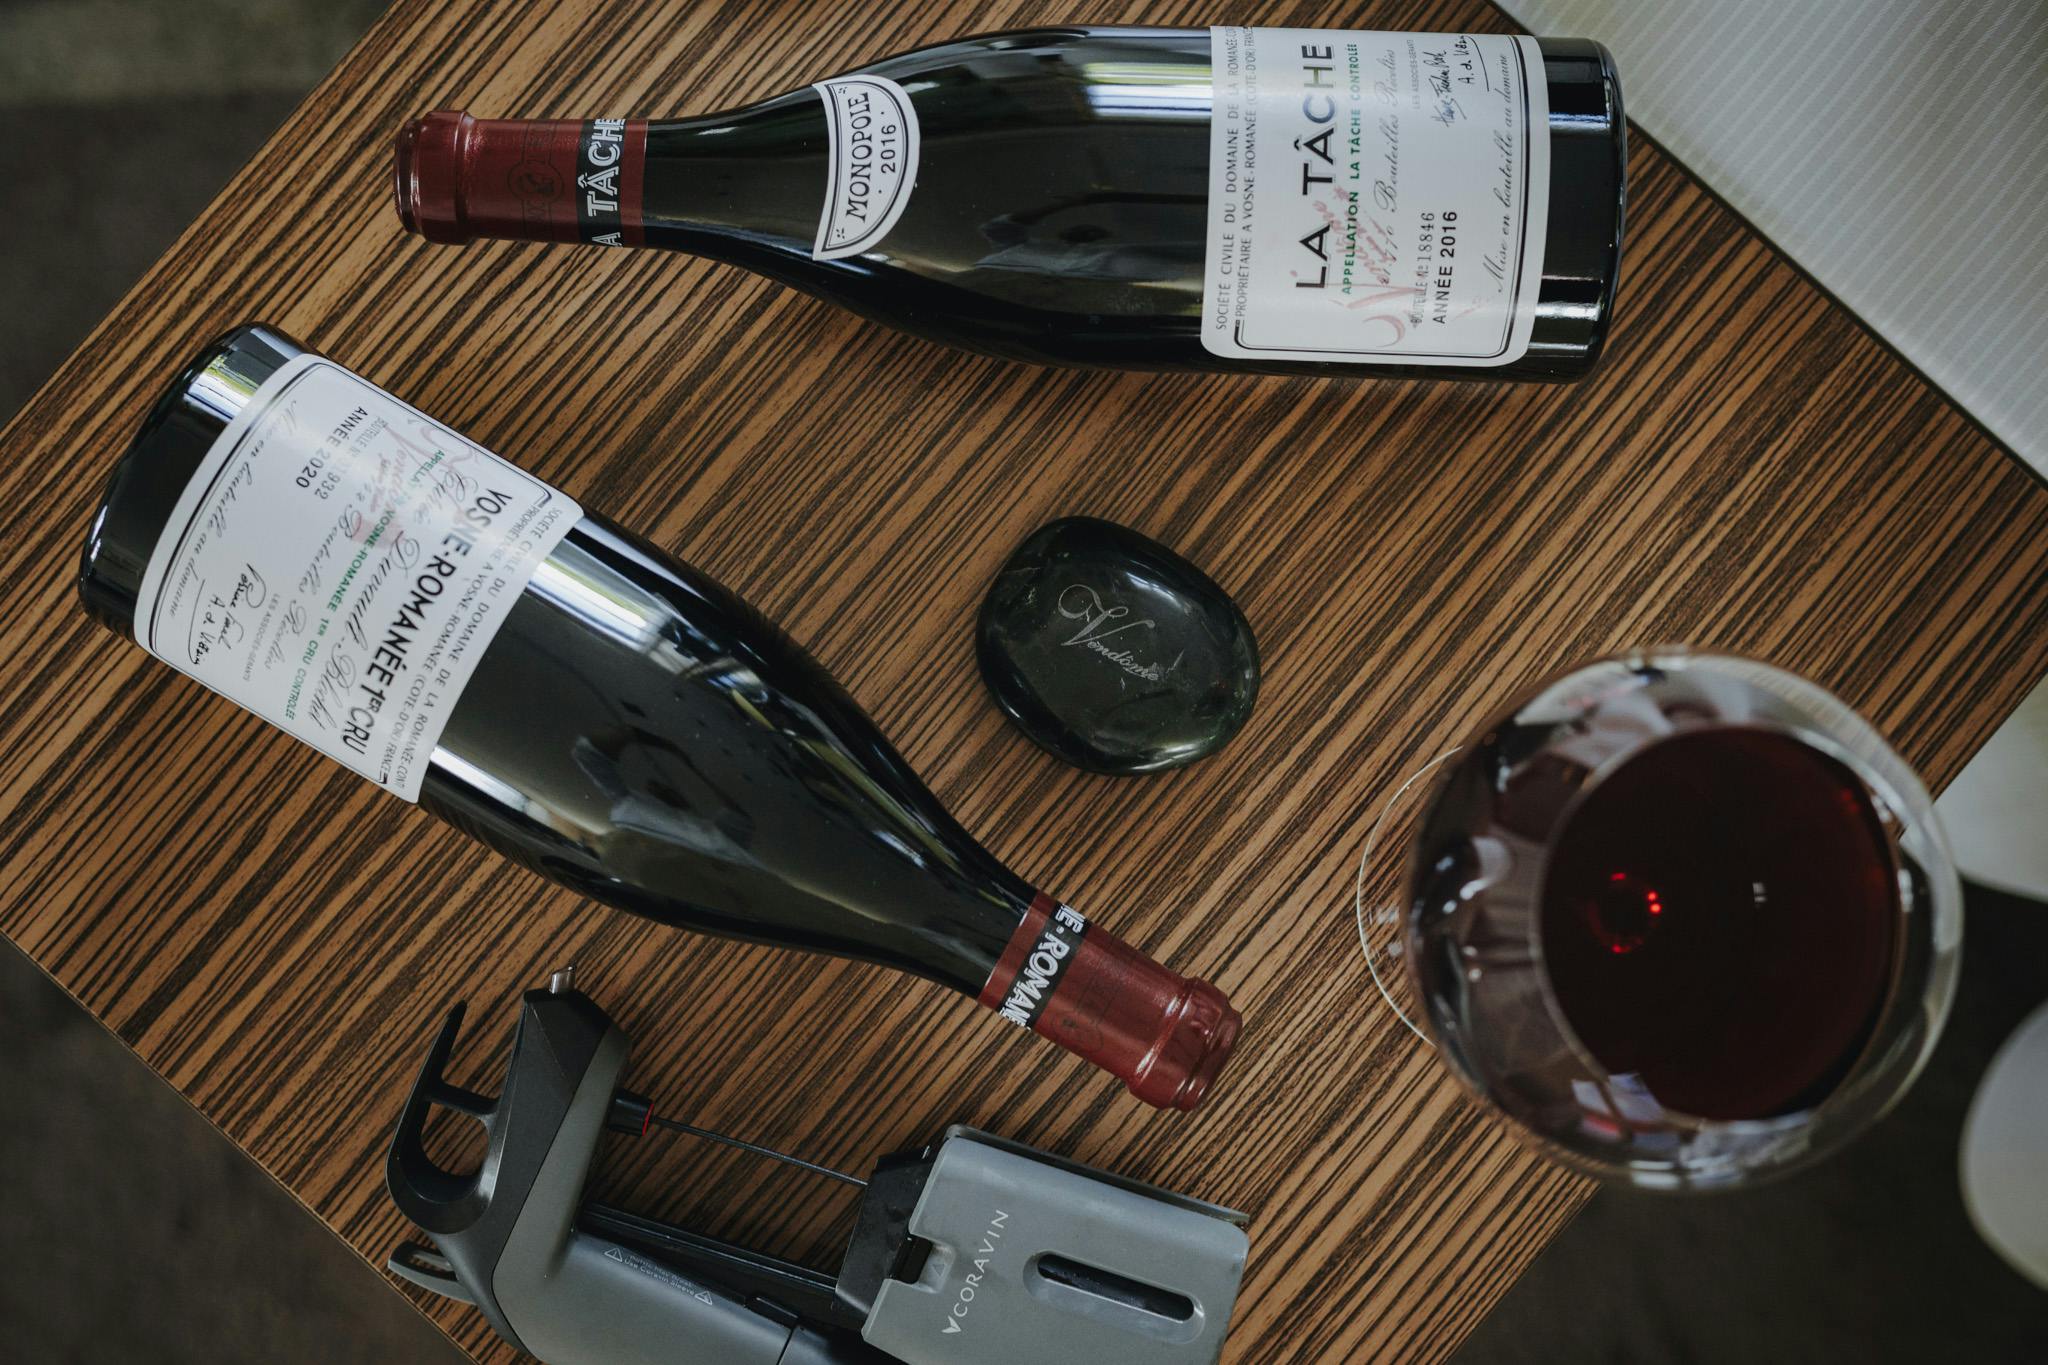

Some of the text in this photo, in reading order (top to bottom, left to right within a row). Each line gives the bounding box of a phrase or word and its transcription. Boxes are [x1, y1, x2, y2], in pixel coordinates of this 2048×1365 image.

[1227, 84, 1238, 96] LA
[1228, 104, 1238, 119] DE
[881, 125, 895, 173] 2016
[1348, 109, 1360, 153] TÂCHE
[577, 117, 625, 215] TÂCHE
[845, 92, 873, 222] MONOPOLE
[1226, 128, 1238, 193] DOMAINE
[1294, 45, 1334, 289] LA TÂCHE
[1349, 162, 1360, 179] LA
[1374, 114, 1398, 212] Bouteilles
[1483, 55, 1512, 292] Mise en bouteille au domaine
[1224, 203, 1236, 223] DU
[1220, 234, 1233, 274] CIVILE
[1342, 192, 1358, 294] APPELLATION
[1236, 238, 1251, 316] PROPRIÉTAIRE
[1244, 224, 1252, 232] A
[1433, 212, 1457, 324] ANNÉE 2016
[1216, 282, 1230, 330] SOCIÉTÉ
[249, 438, 264, 458] en
[325, 406, 368, 448] ANNÉE
[294, 447, 331, 489] 2020
[206, 461, 255, 537] bouteille
[530, 507, 562, 538] SOCIÉTÉ
[192, 532, 208, 555] au
[297, 504, 362, 595] Bouteilles
[326, 512, 395, 612] VOSNE-ROMANÉE
[481, 561, 492, 571] A
[168, 557, 199, 615] domaine
[365, 489, 512, 686] VOSNE-ROMANÉE
[486, 576, 506, 597] DU
[301, 640, 318, 664] CRU
[447, 601, 489, 663] DOMAINE
[423, 691, 438, 708] LA
[433, 667, 450, 687] DE
[342, 709, 373, 755] CRU
[955, 1209, 1008, 1316] CORAVIN
